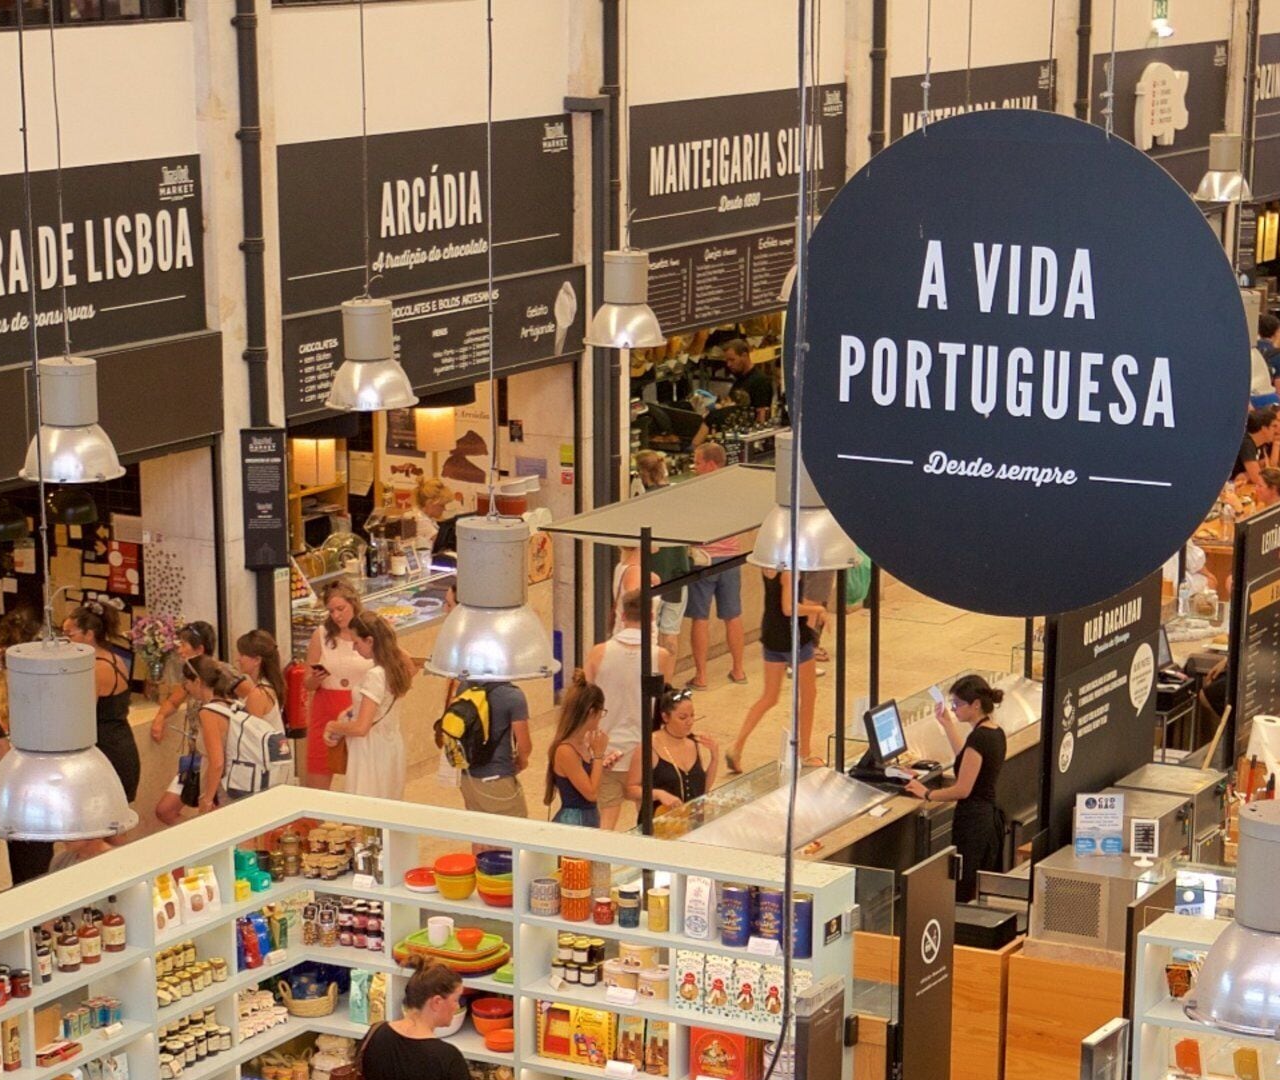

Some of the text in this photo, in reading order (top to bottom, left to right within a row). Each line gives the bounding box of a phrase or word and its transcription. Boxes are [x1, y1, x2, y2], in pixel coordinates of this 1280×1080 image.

[649, 131, 771, 197] MANTEIGARIA
[159, 183, 194, 196] MARKET
[380, 164, 483, 239] ARCÁDIA
[37, 222, 78, 291] DE
[84, 207, 194, 283] LISBOA
[371, 237, 488, 272] A tradição do chocolate
[917, 239, 1096, 320] A VIDA
[10, 311, 30, 332] de
[32, 304, 96, 328] consrvas
[392, 301, 431, 318] HOCOLATES
[438, 296, 461, 311] BOLOS
[298, 338, 338, 354] CHOCOLATES
[838, 334, 1176, 428] PORTUGUESA
[923, 450, 1078, 488] Desde sempre
[1104, 596, 1142, 636] BACALHAU
